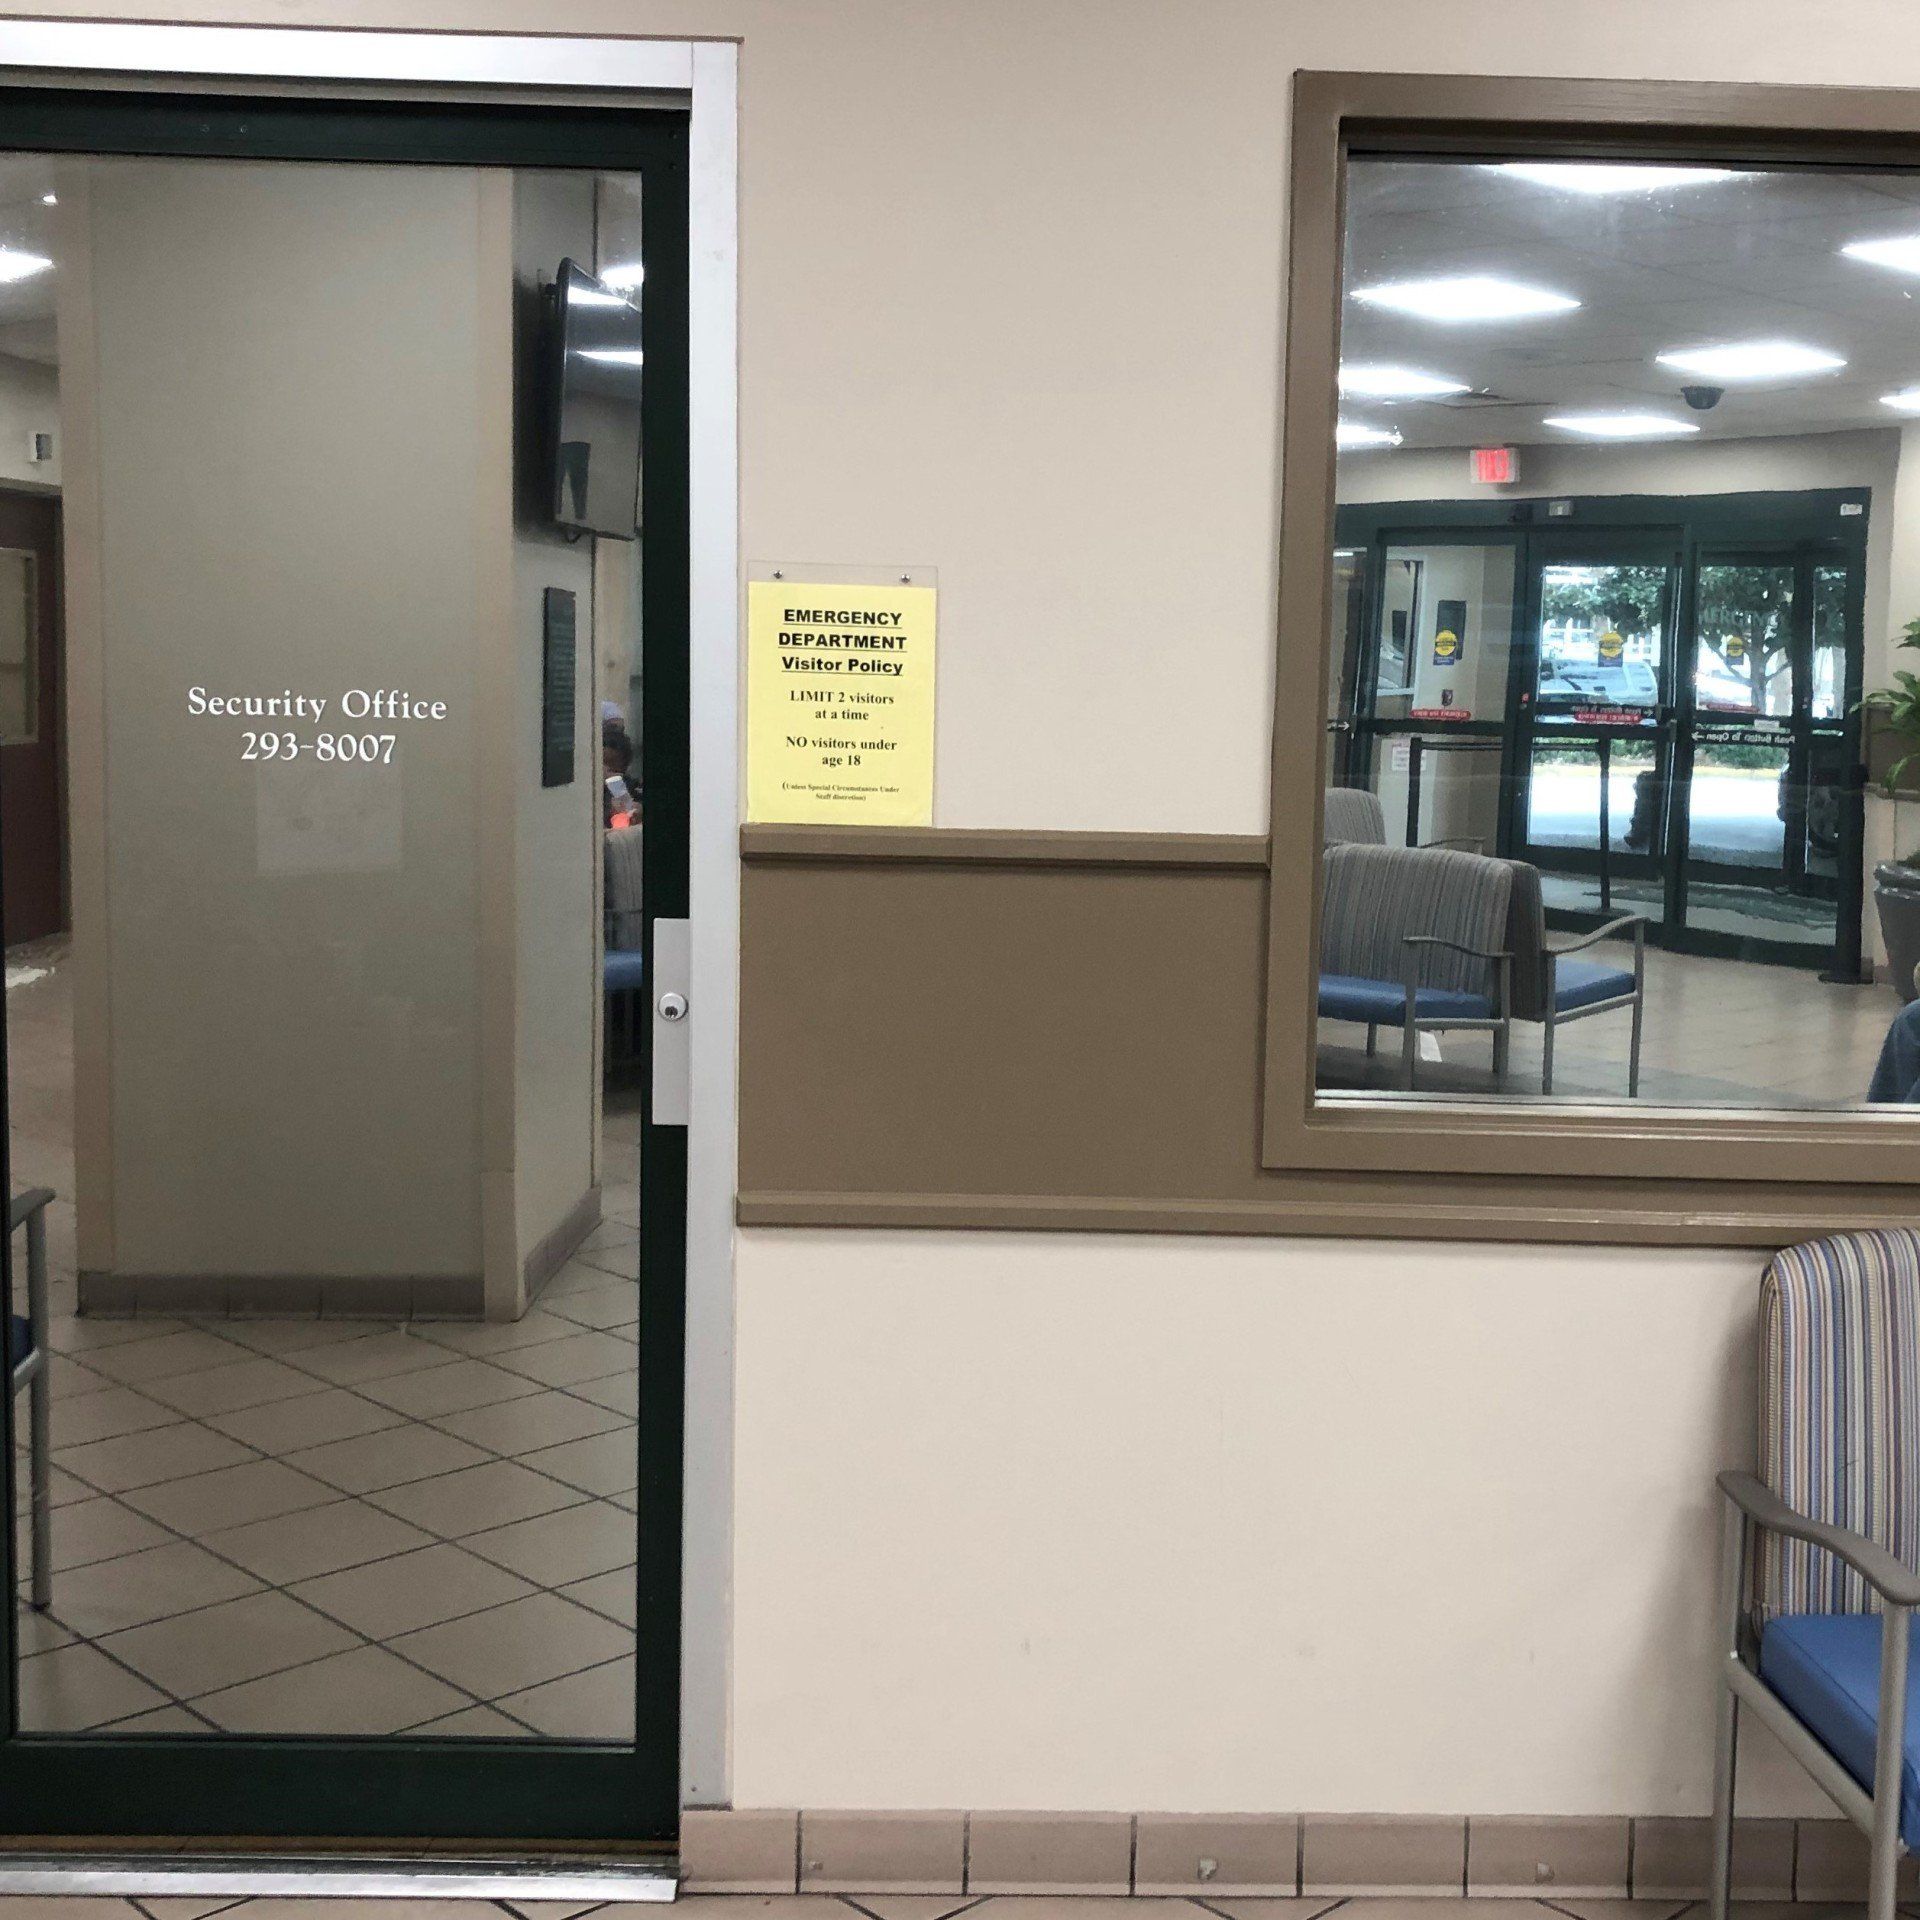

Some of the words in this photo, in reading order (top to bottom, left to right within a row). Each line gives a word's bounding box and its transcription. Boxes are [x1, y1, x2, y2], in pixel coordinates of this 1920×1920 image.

[784, 609, 902, 626] EMERGENCY
[779, 632, 907, 650] DEPARTMENT
[782, 656, 842, 671] Visitor
[848, 658, 903, 675] Policy
[187, 686, 327, 723] Security
[341, 689, 447, 720] Office
[790, 690, 834, 702] LIMIT
[838, 691, 845, 703] 2
[849, 692, 894, 704] visitors
[815, 709, 827, 719] at
[830, 711, 838, 719] a
[841, 708, 869, 720] time
[241, 732, 396, 764] 293-8007
[786, 736, 808, 748] NO
[812, 737, 856, 749] visitors
[860, 739, 897, 750] under
[822, 756, 843, 767] age
[847, 754, 861, 766] 18
